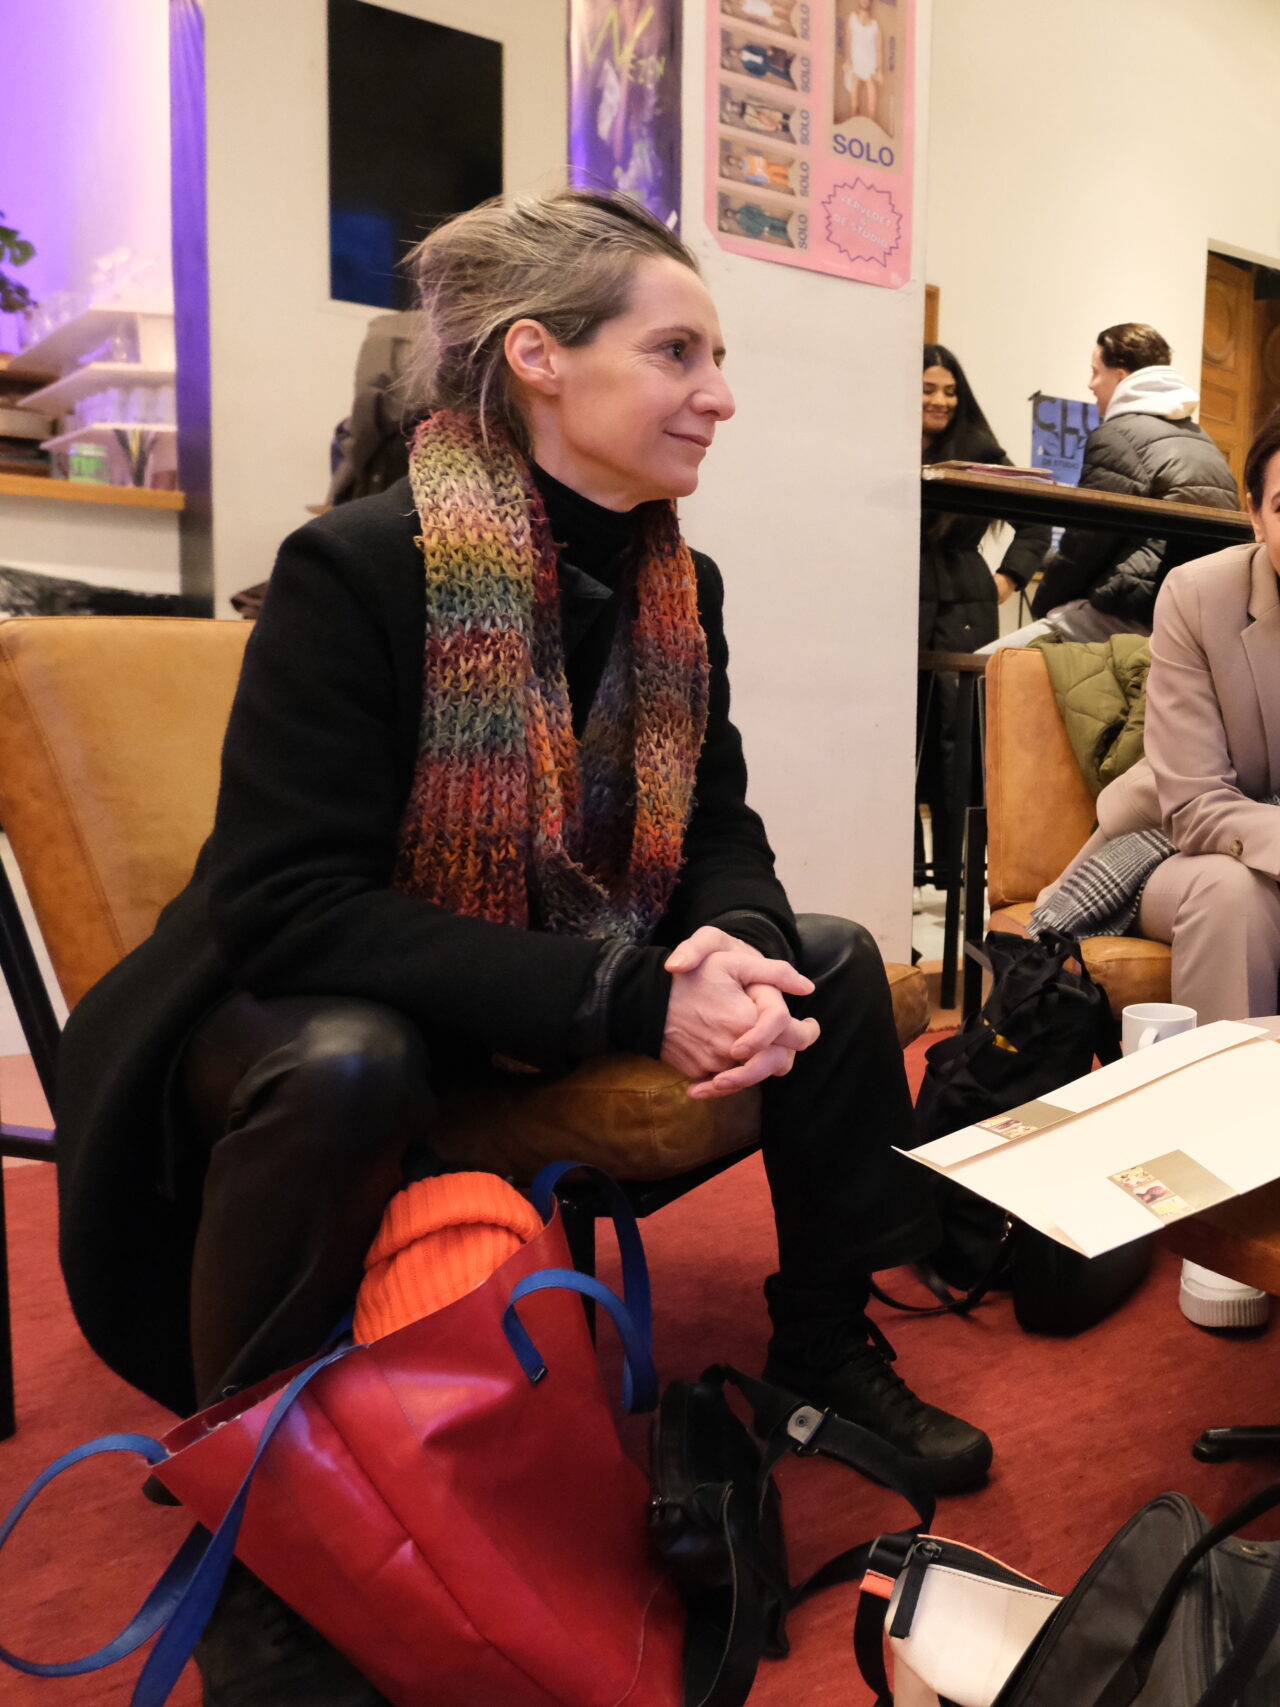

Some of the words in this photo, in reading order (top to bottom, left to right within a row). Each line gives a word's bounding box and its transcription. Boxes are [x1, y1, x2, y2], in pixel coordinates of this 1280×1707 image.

[799, 4, 811, 40] SOLO
[799, 57, 811, 93] SOLO
[799, 110, 811, 145] SOLO
[833, 133, 895, 168] SOLO
[799, 162, 810, 197] SOLO
[798, 214, 809, 250] SOLO
[850, 222, 889, 249] STUDIO
